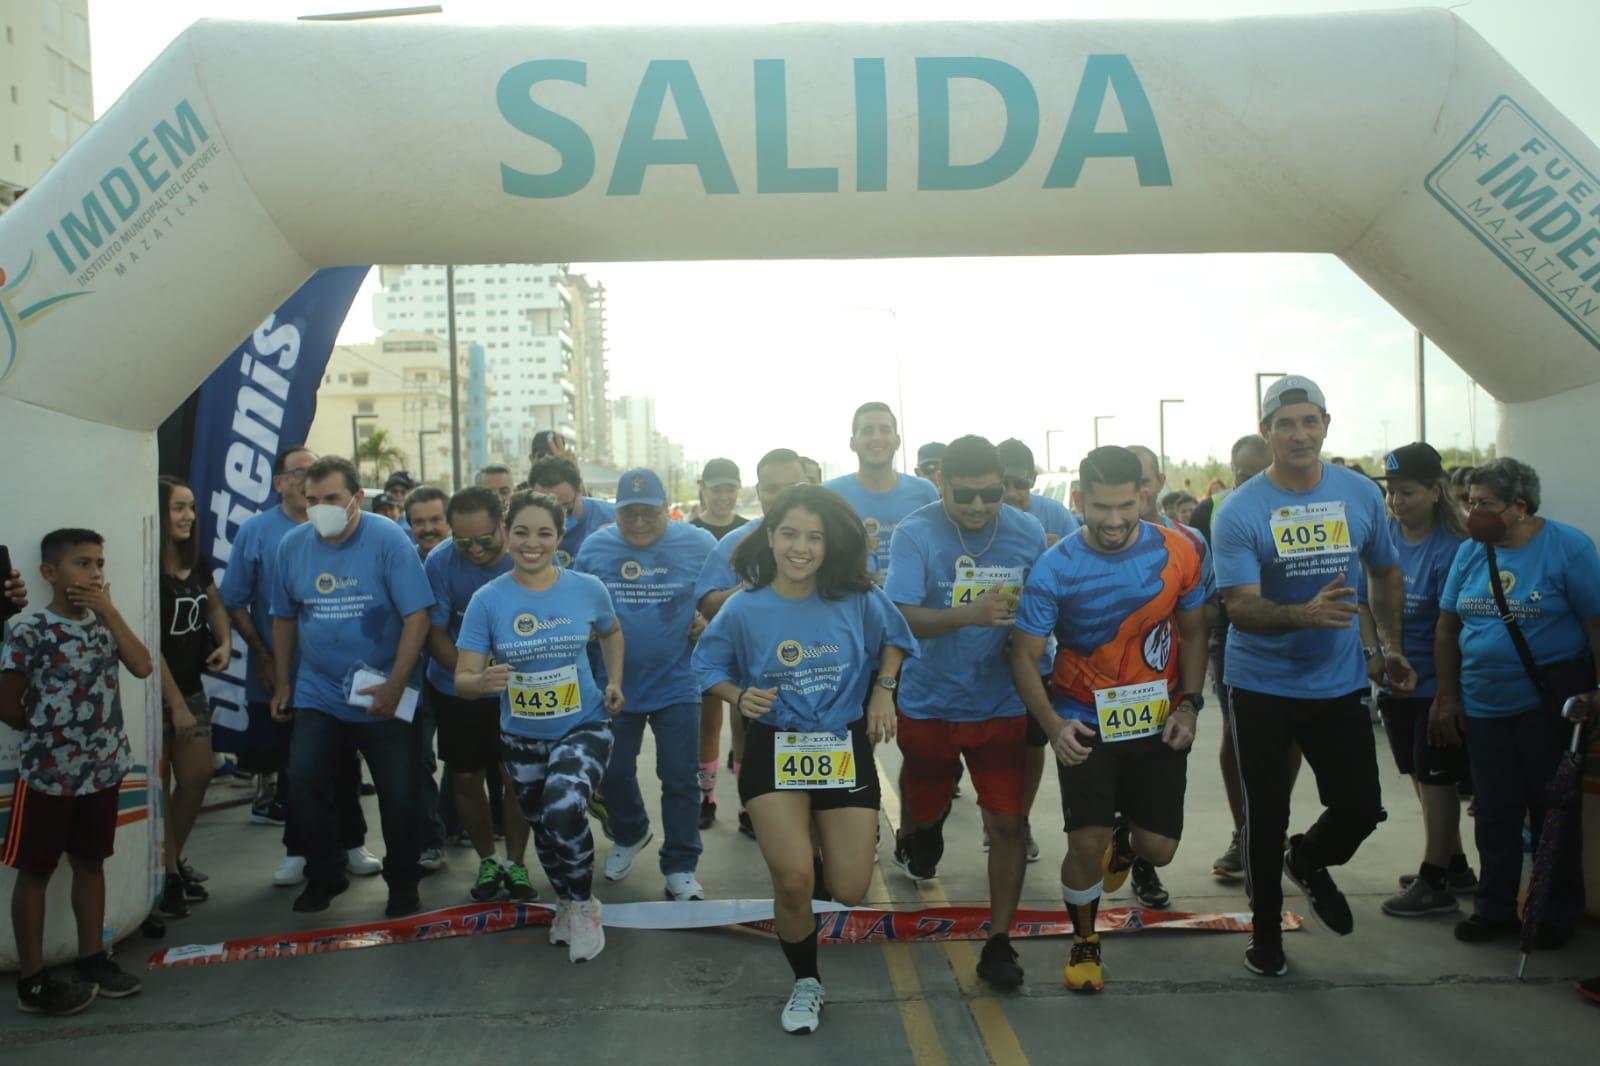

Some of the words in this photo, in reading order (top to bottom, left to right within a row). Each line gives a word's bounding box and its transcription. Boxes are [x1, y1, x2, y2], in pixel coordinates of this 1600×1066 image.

[495, 53, 1174, 199] SALIDA
[45, 97, 210, 275] IMDEM
[76, 239, 123, 288] INSTITUTO
[118, 197, 169, 246] MUNICIPAL
[163, 180, 185, 201] DEL
[180, 141, 221, 185] DEPORTE
[113, 180, 210, 278] MAZATLAN
[1475, 151, 1600, 295] IMDE
[1280, 524, 1328, 546] 405
[515, 691, 558, 709] 443
[1106, 704, 1153, 728] 404
[782, 755, 832, 776] 408
